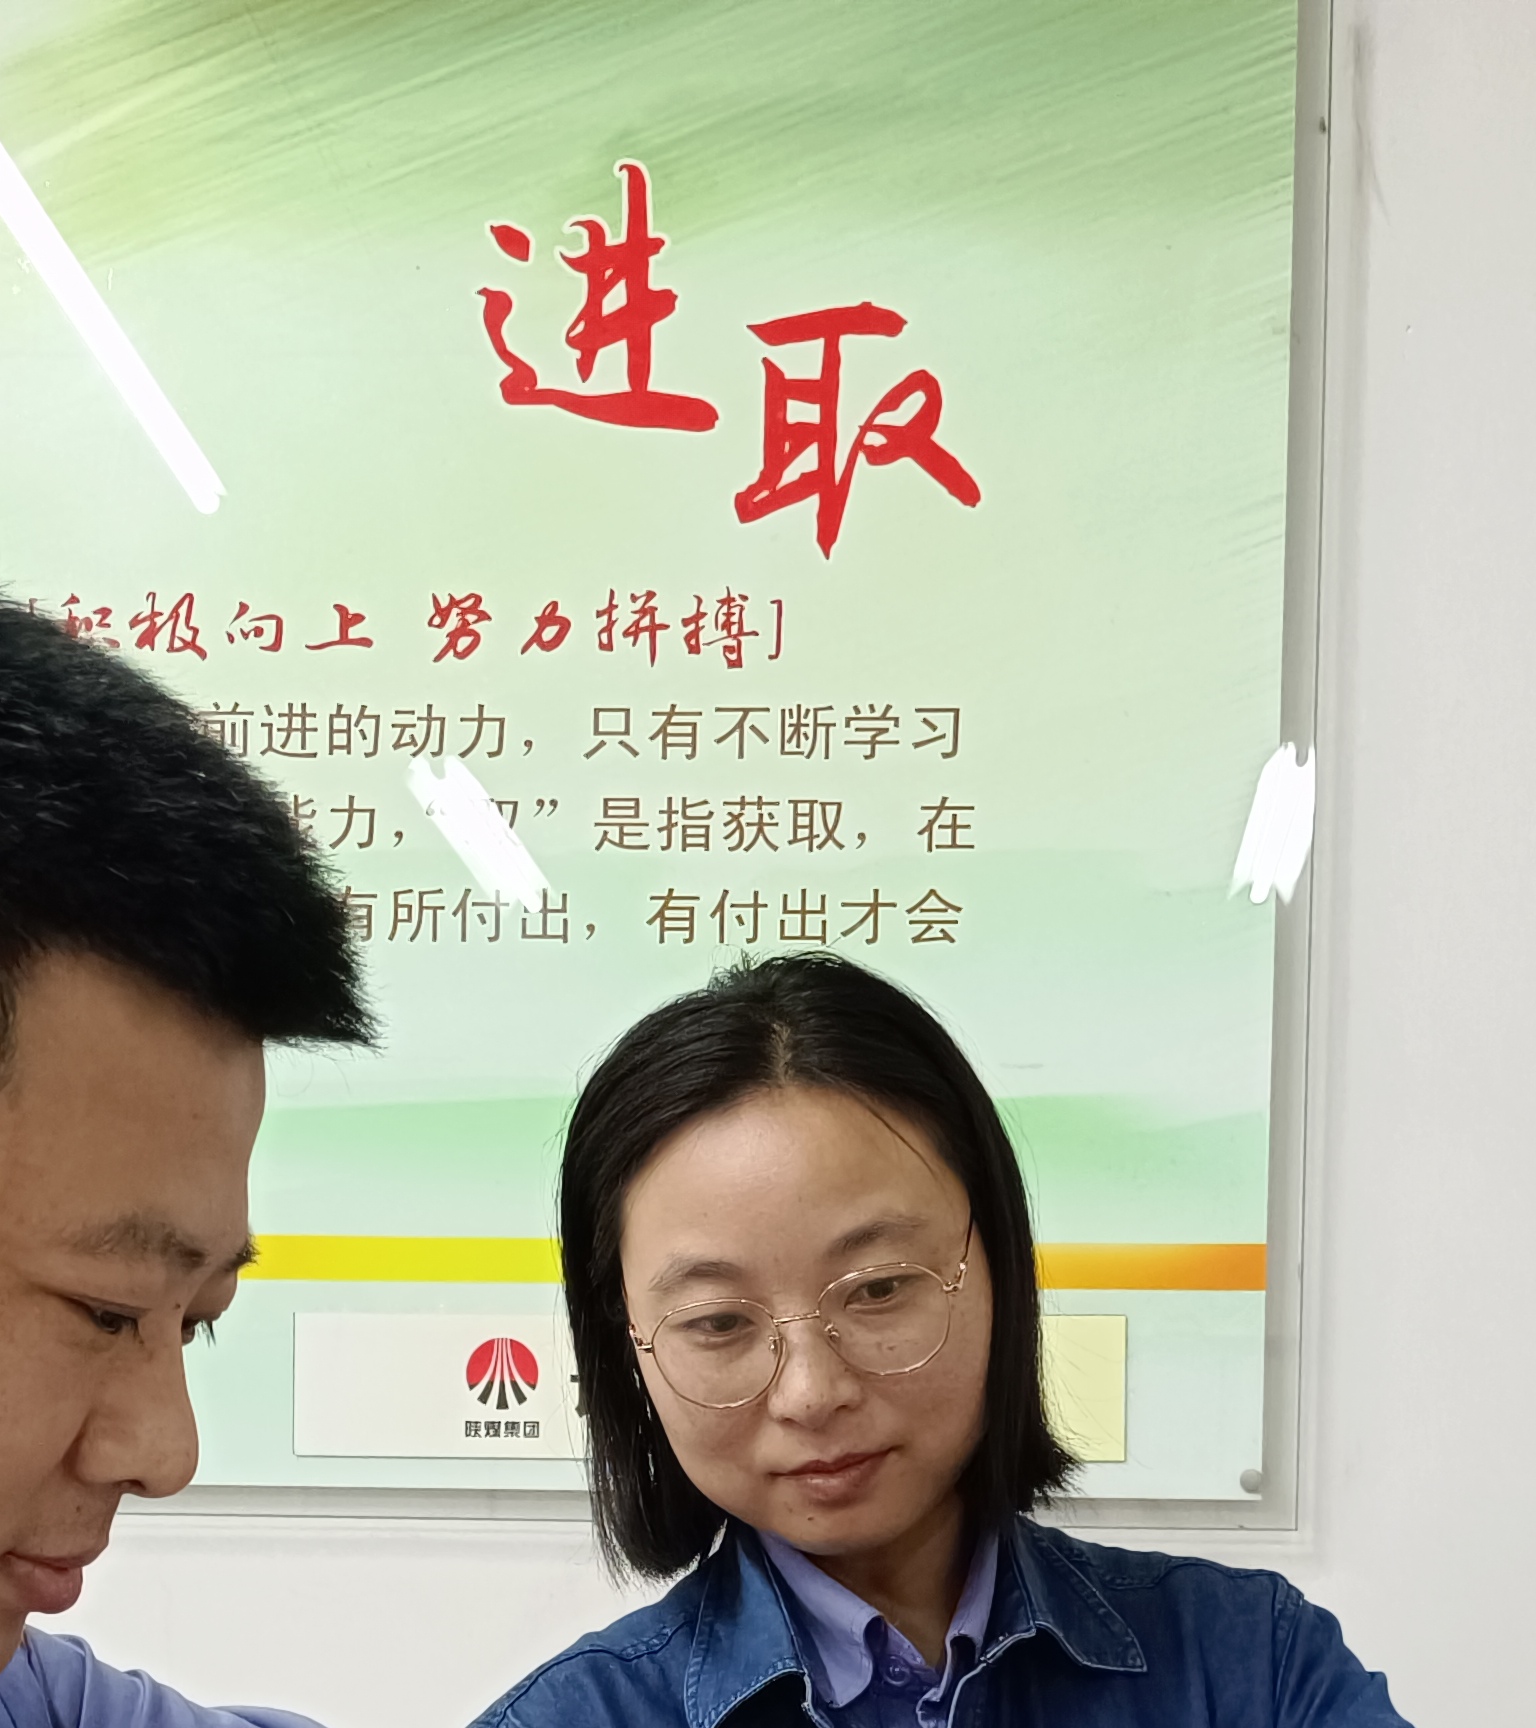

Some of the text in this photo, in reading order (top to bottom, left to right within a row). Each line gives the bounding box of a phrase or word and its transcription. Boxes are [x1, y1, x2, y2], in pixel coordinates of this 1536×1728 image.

[477, 161, 981, 559] 进取
[30, 592, 373, 660] 积极向上
[202, 702, 962, 760] 前进的动力，只有不断学习
[465, 1420, 540, 1438] 陕煤集团
